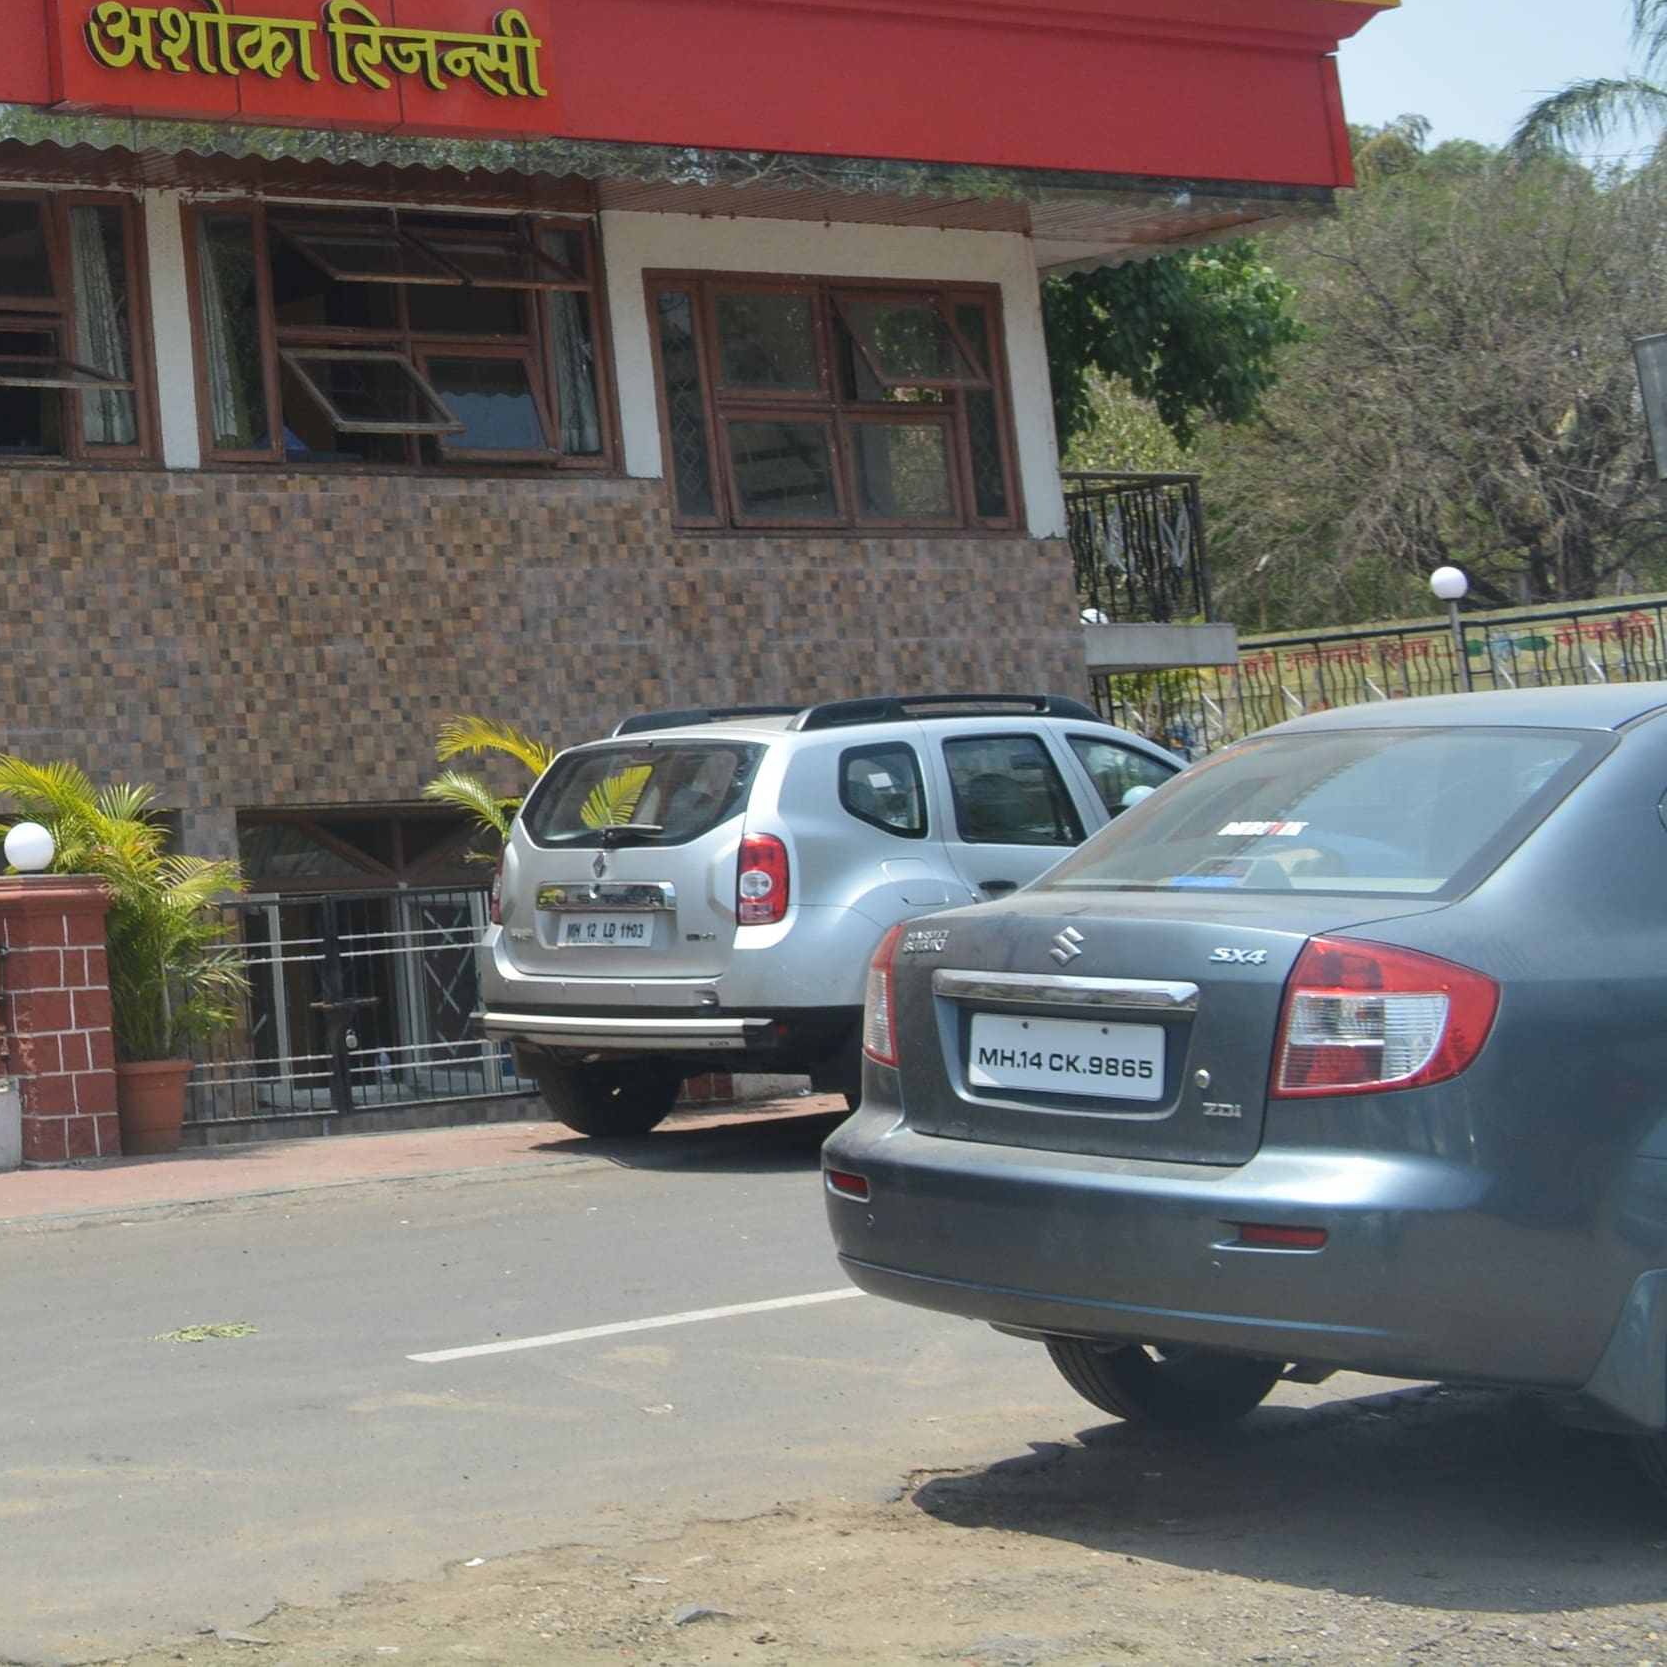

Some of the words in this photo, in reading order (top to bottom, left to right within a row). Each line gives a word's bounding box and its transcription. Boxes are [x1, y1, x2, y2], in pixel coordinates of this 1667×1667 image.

[567, 923, 581, 937] MH
[587, 923, 597, 937] 12
[603, 923, 616, 938] LD
[1209, 946, 1267, 965] SX4
[978, 1047, 1043, 1072] MH.14
[1048, 1052, 1154, 1080] CK.9865
